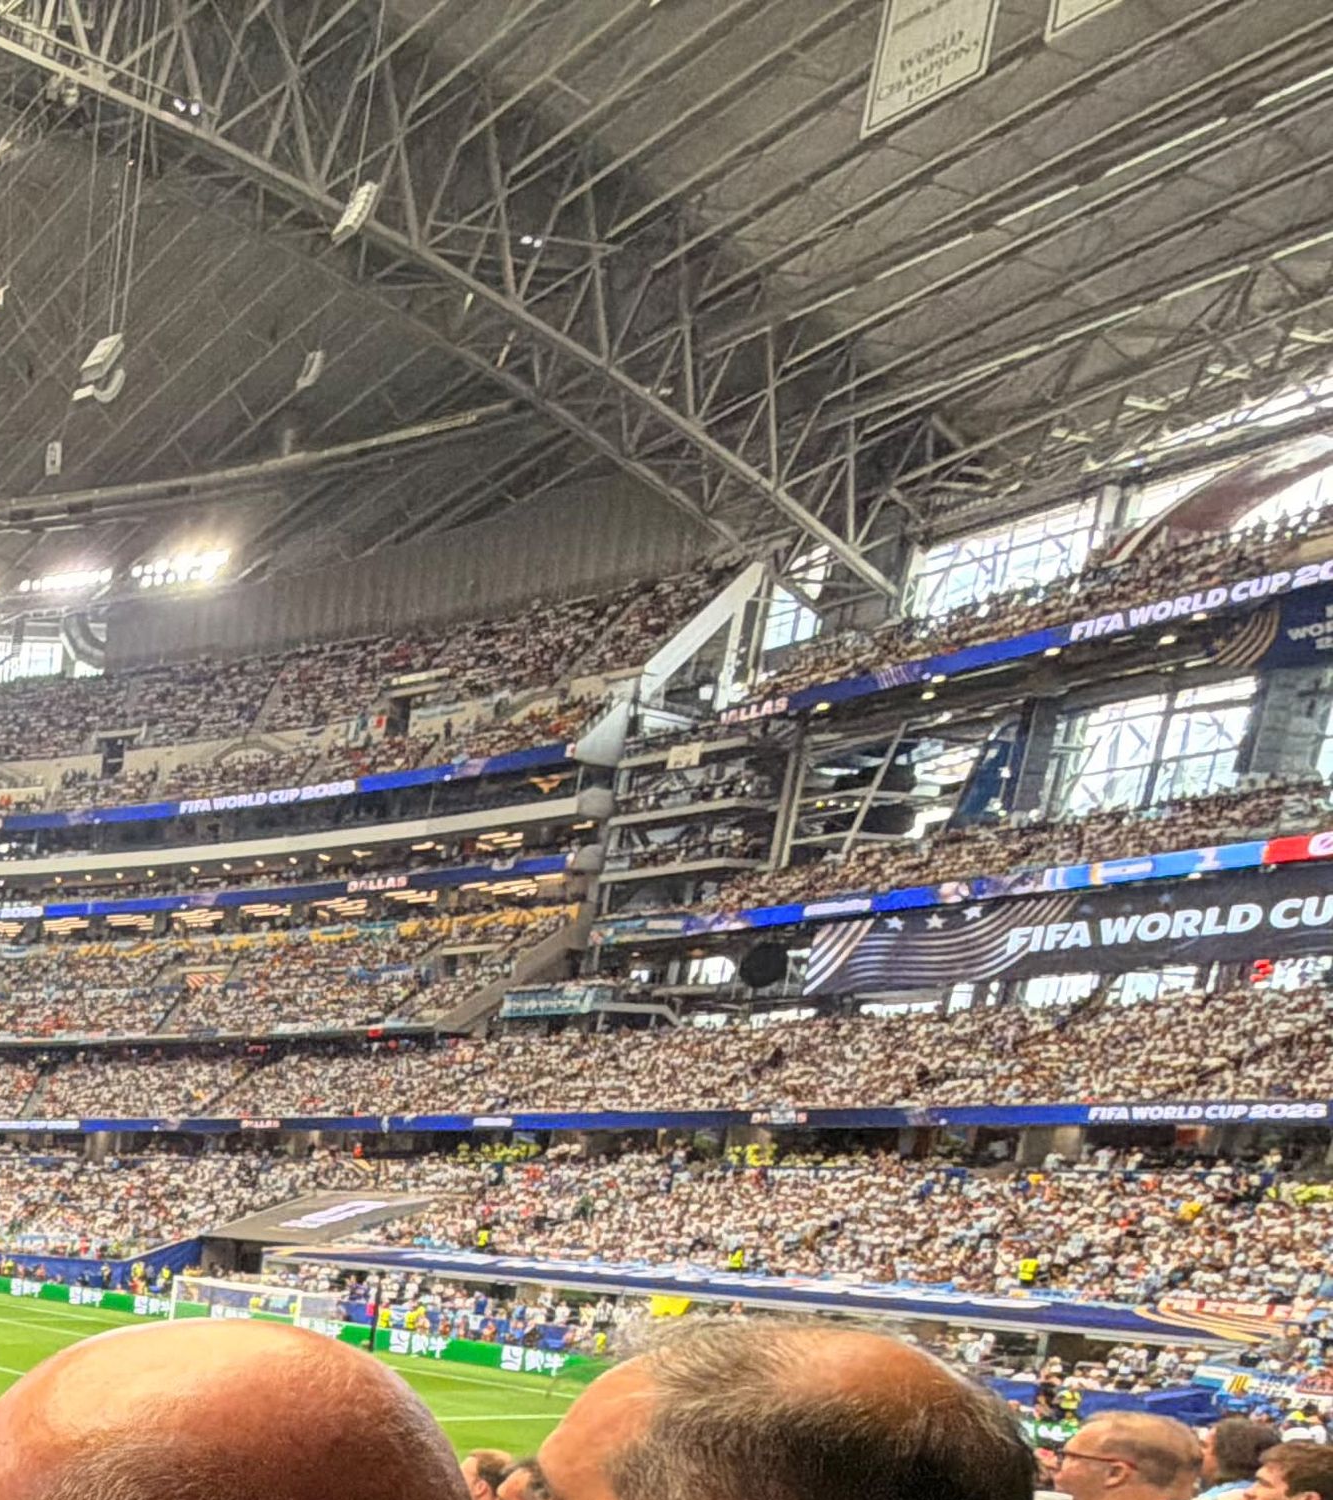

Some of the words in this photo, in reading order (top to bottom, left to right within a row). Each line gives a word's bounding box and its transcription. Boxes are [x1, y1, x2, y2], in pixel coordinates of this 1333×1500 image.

[1069, 611, 1125, 642] FIFA
[1129, 587, 1228, 628] WORLD
[1230, 571, 1292, 602] CUP
[179, 797, 211, 815] FIFA
[213, 791, 267, 811] WORLD
[269, 786, 300, 806] CUP
[347, 876, 408, 892] DALLAS
[1006, 920, 1091, 952] FIFA
[1099, 902, 1263, 945] WORLD
[1088, 1106, 1129, 1121] FIFA
[1131, 1105, 1205, 1120] WORLD
[1205, 1104, 1248, 1119] CUP
[1248, 1103, 1327, 1119] 2026
